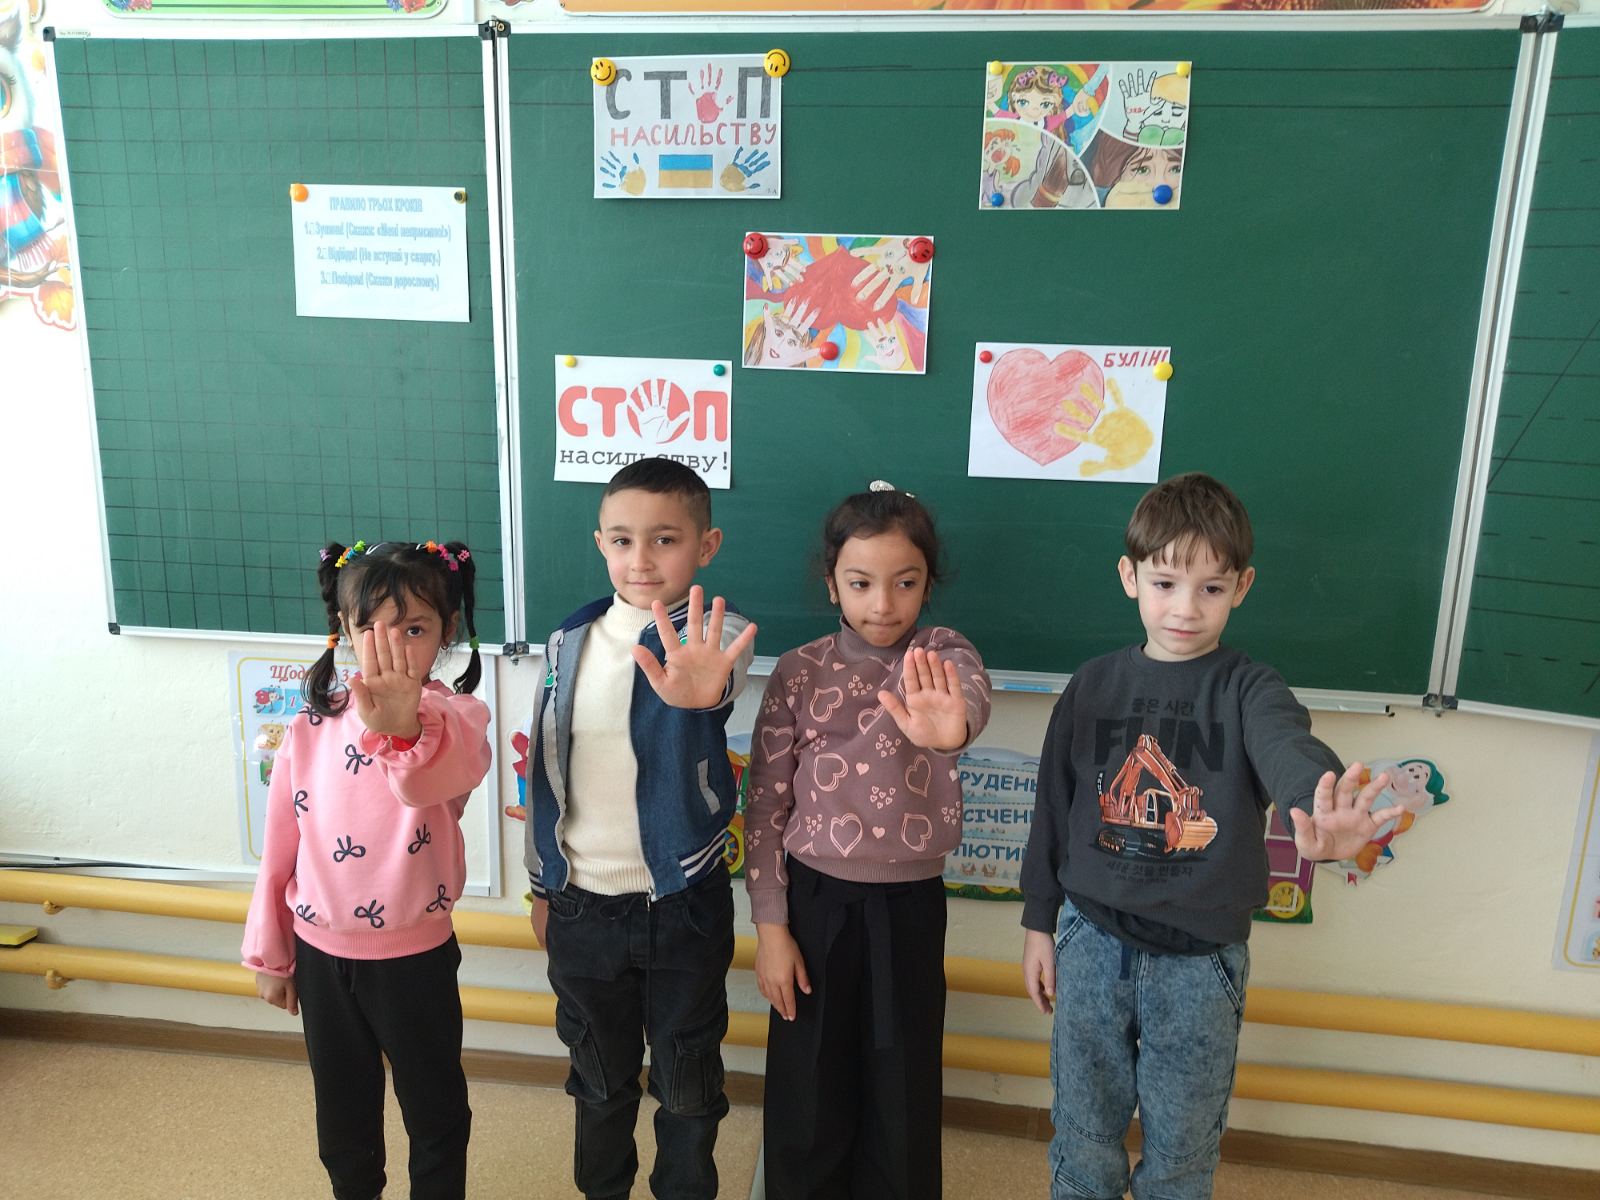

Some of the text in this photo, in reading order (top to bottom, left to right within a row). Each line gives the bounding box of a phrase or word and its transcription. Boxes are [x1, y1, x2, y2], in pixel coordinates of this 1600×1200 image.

[610, 122, 777, 146] НАСИЛЬСТВУ
[329, 196, 366, 211] ПРАВИЛО
[560, 450, 728, 473] насилтву!
[1094, 717, 1225, 771] FUN
[959, 771, 1037, 792] РУДЕНЬ
